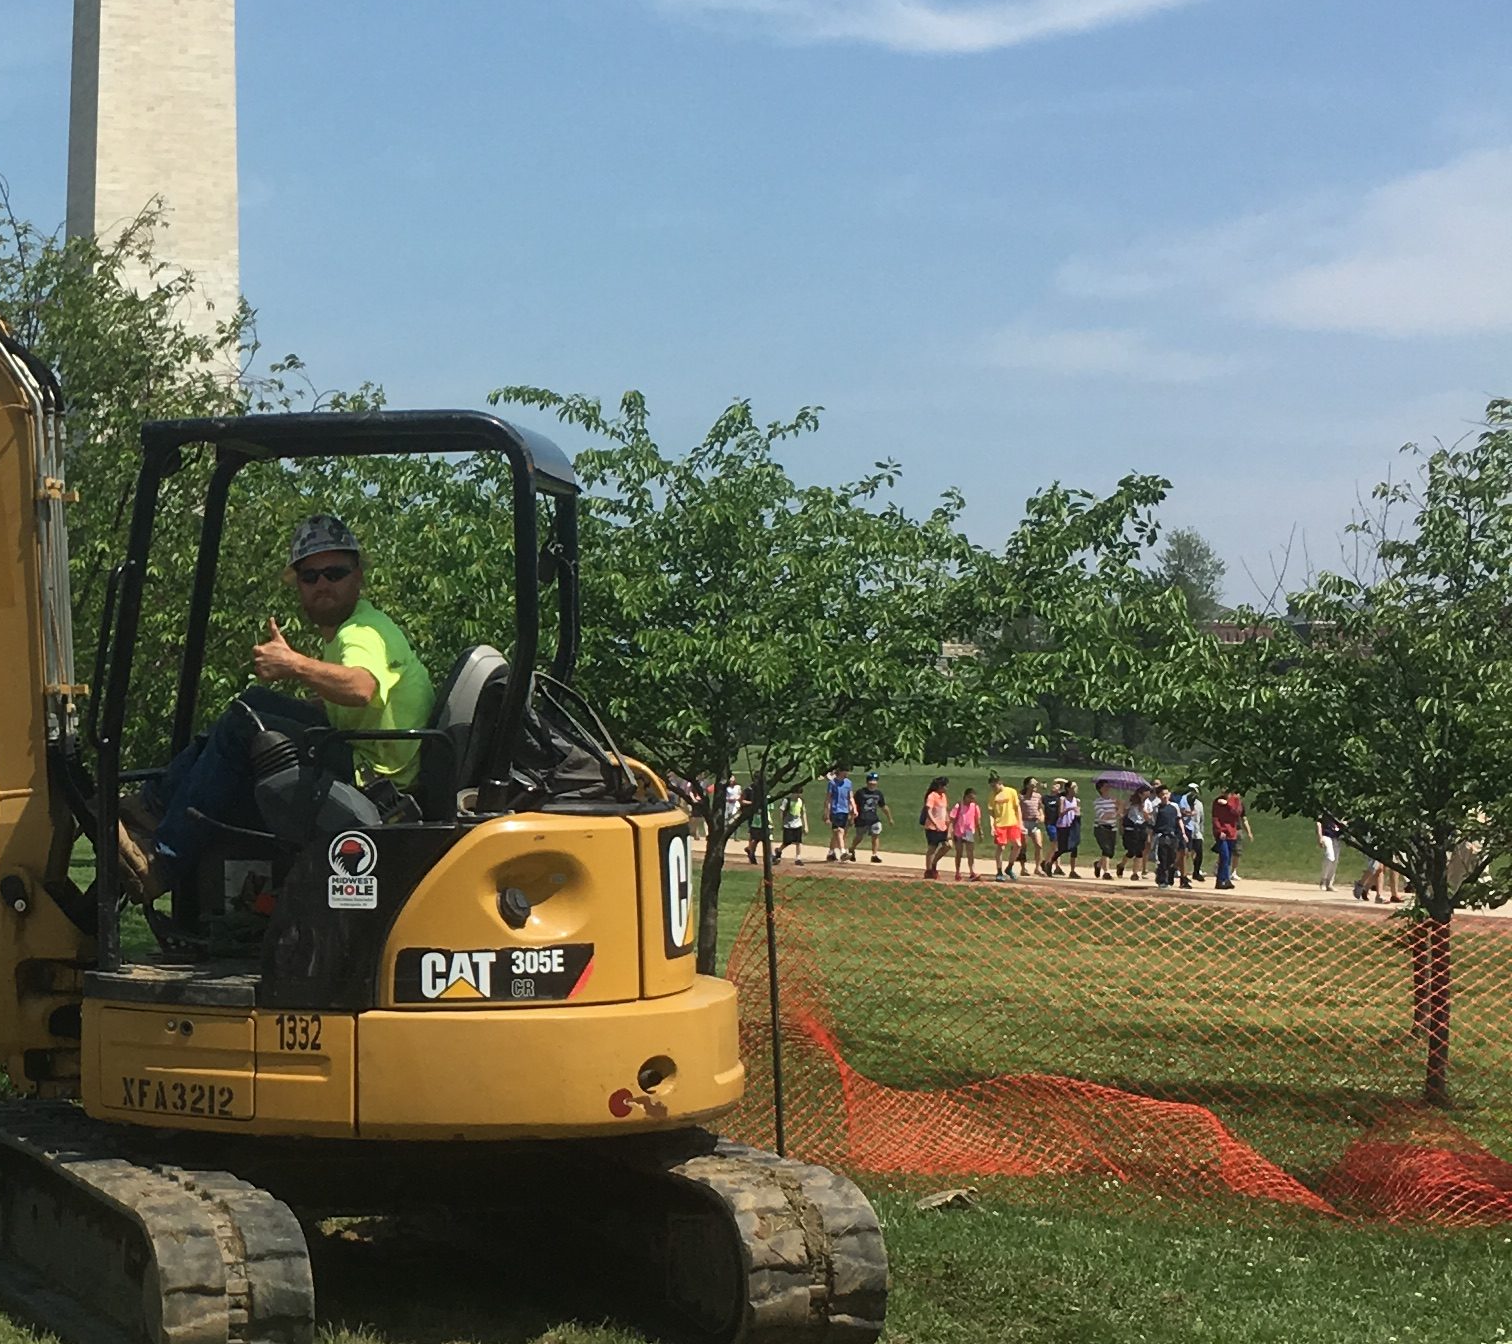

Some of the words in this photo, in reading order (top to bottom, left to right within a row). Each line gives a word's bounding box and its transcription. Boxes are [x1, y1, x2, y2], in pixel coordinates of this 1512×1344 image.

[332, 885, 374, 895] MOLE
[421, 952, 496, 998] CAT
[511, 949, 565, 974] 305E
[511, 978, 535, 997] CR
[275, 1013, 322, 1050] 1332
[122, 1076, 234, 1116] XFA3212
